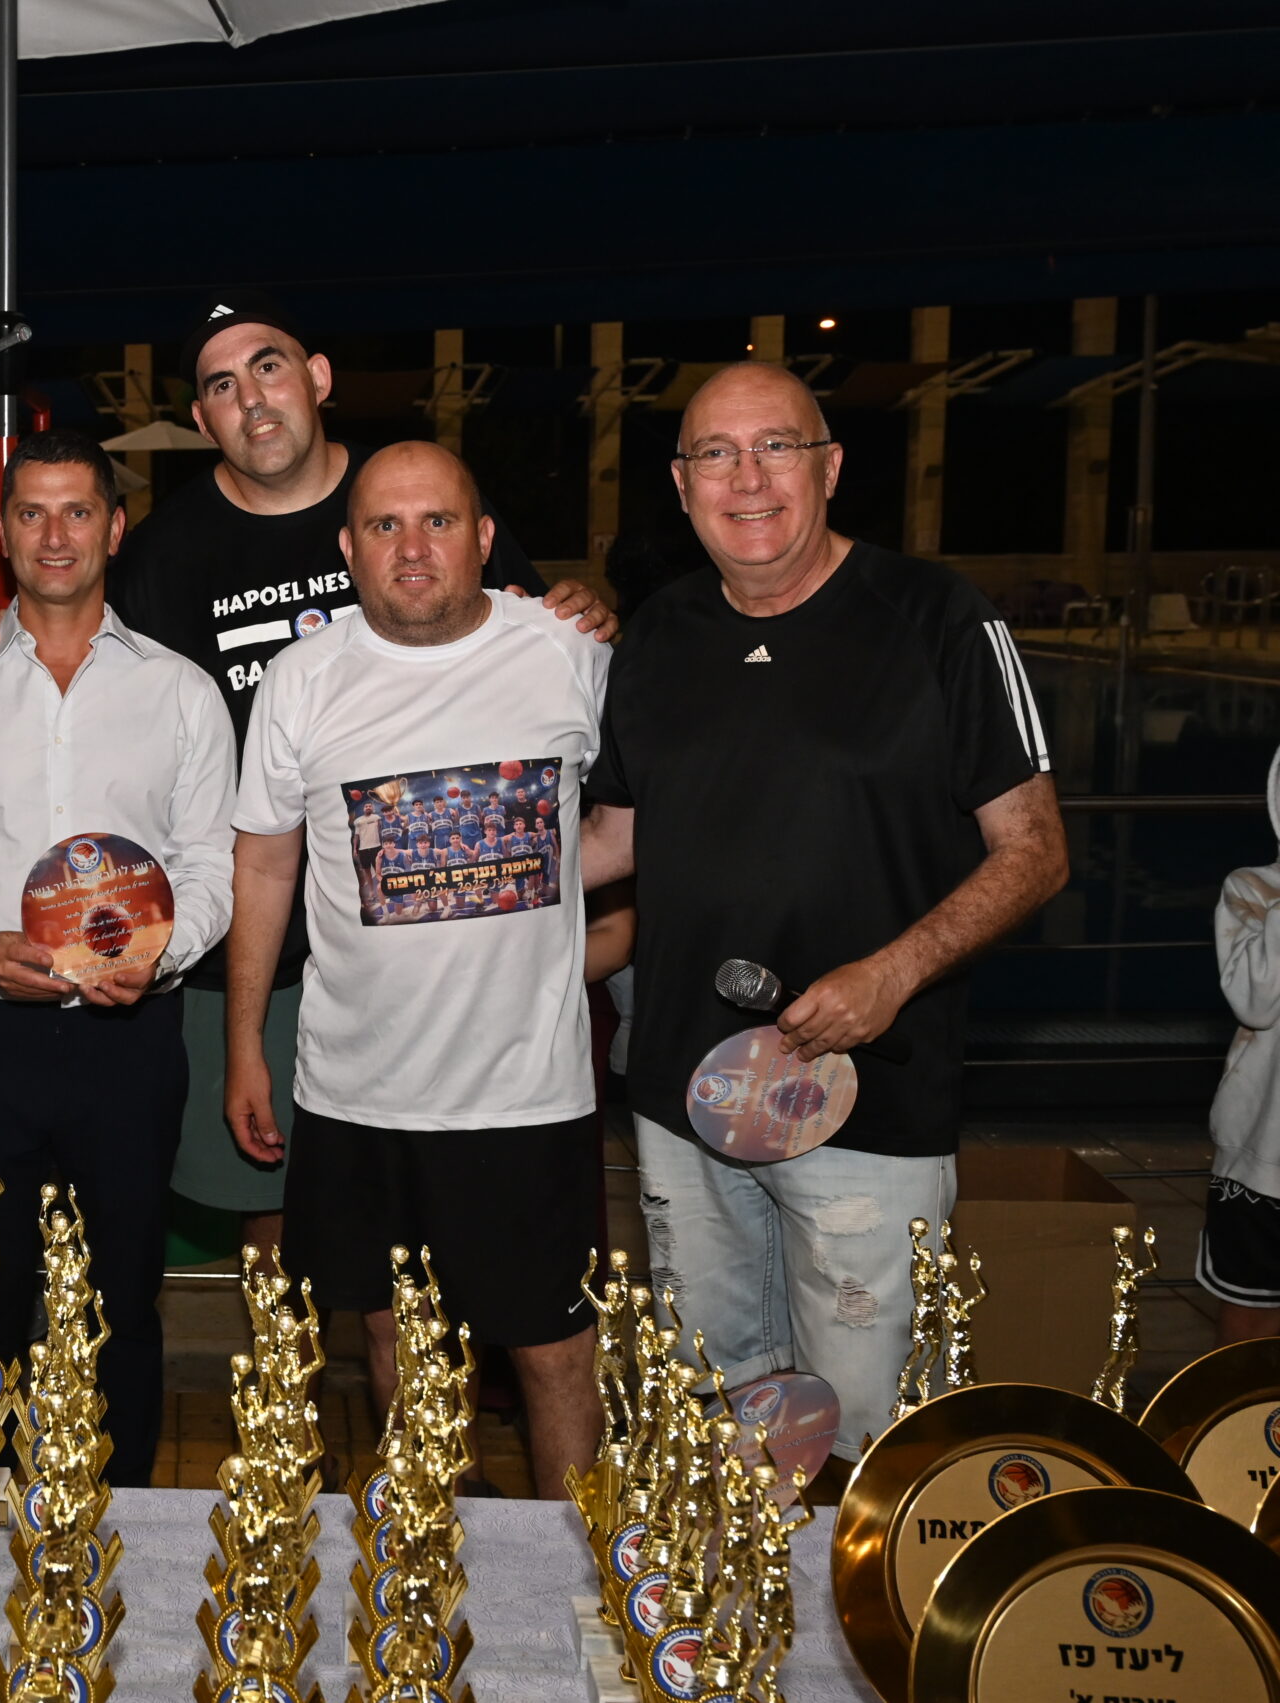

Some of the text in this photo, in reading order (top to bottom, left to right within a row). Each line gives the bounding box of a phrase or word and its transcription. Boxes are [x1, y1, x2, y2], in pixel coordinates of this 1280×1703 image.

[213, 581, 304, 618] HAPOEL
[744, 655, 772, 663] adidas
[227, 659, 272, 691] BA
[113, 866, 128, 878] לוי
[451, 864, 497, 882] נערים
[501, 857, 542, 875] אלופת
[53, 878, 80, 891] העיר
[387, 874, 426, 890] חיפה
[28, 885, 51, 899] נשר
[1058, 1643, 1184, 1673] ליעד פז
